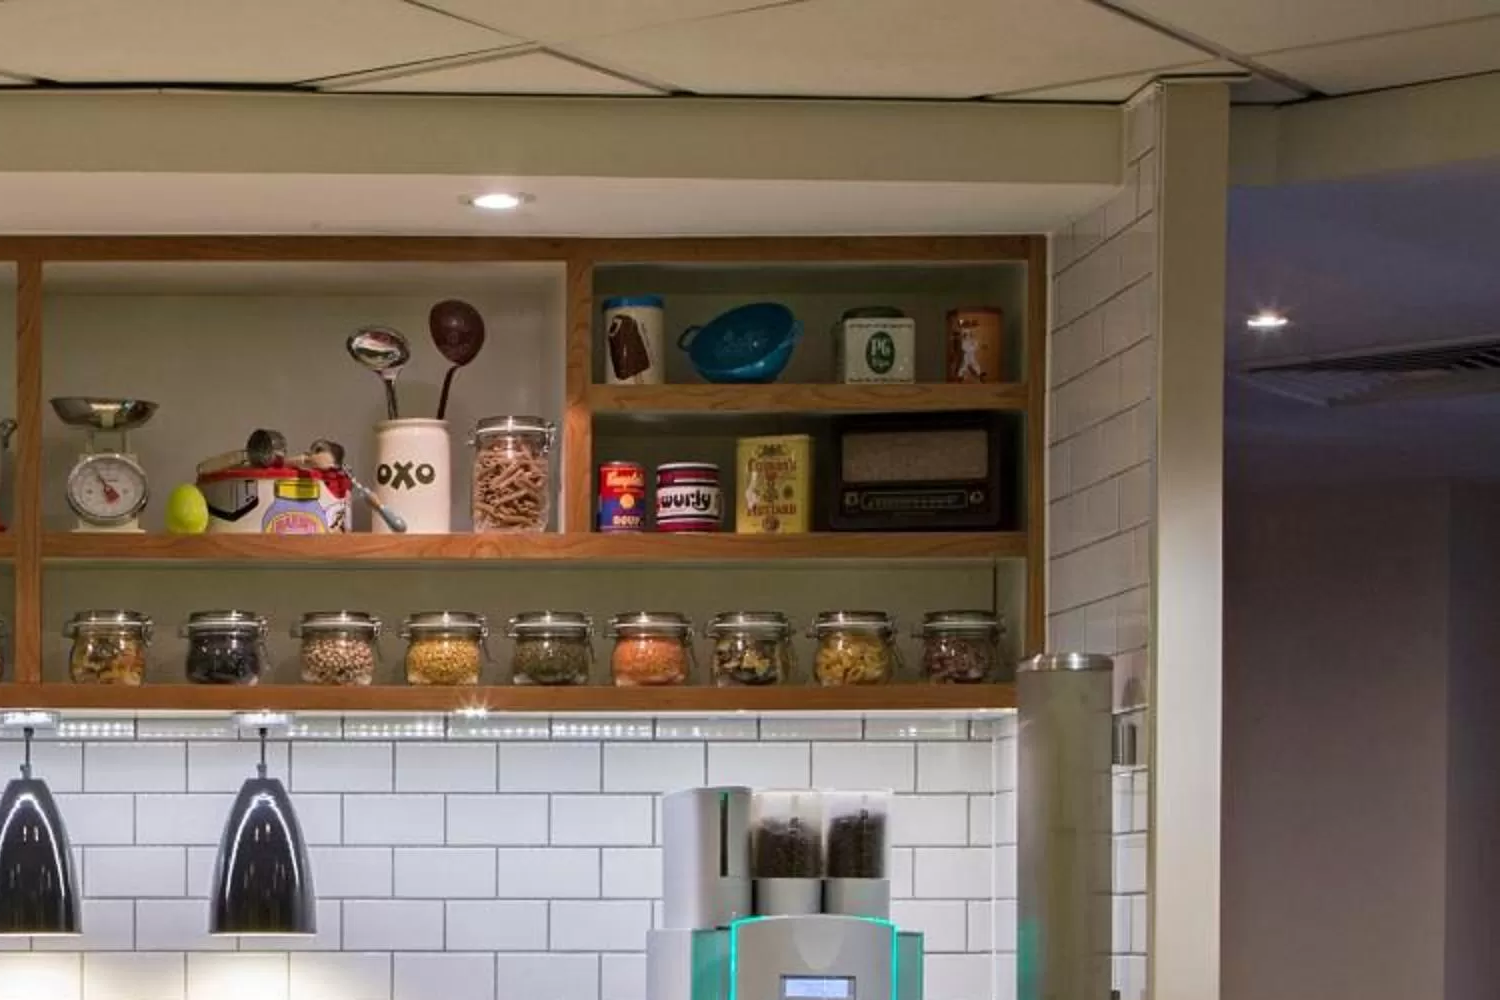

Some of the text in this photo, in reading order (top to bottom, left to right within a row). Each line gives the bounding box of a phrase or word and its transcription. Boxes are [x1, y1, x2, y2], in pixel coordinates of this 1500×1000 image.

[871, 338, 891, 357] PG
[377, 461, 436, 490] OXO
[660, 489, 711, 511] wurly
